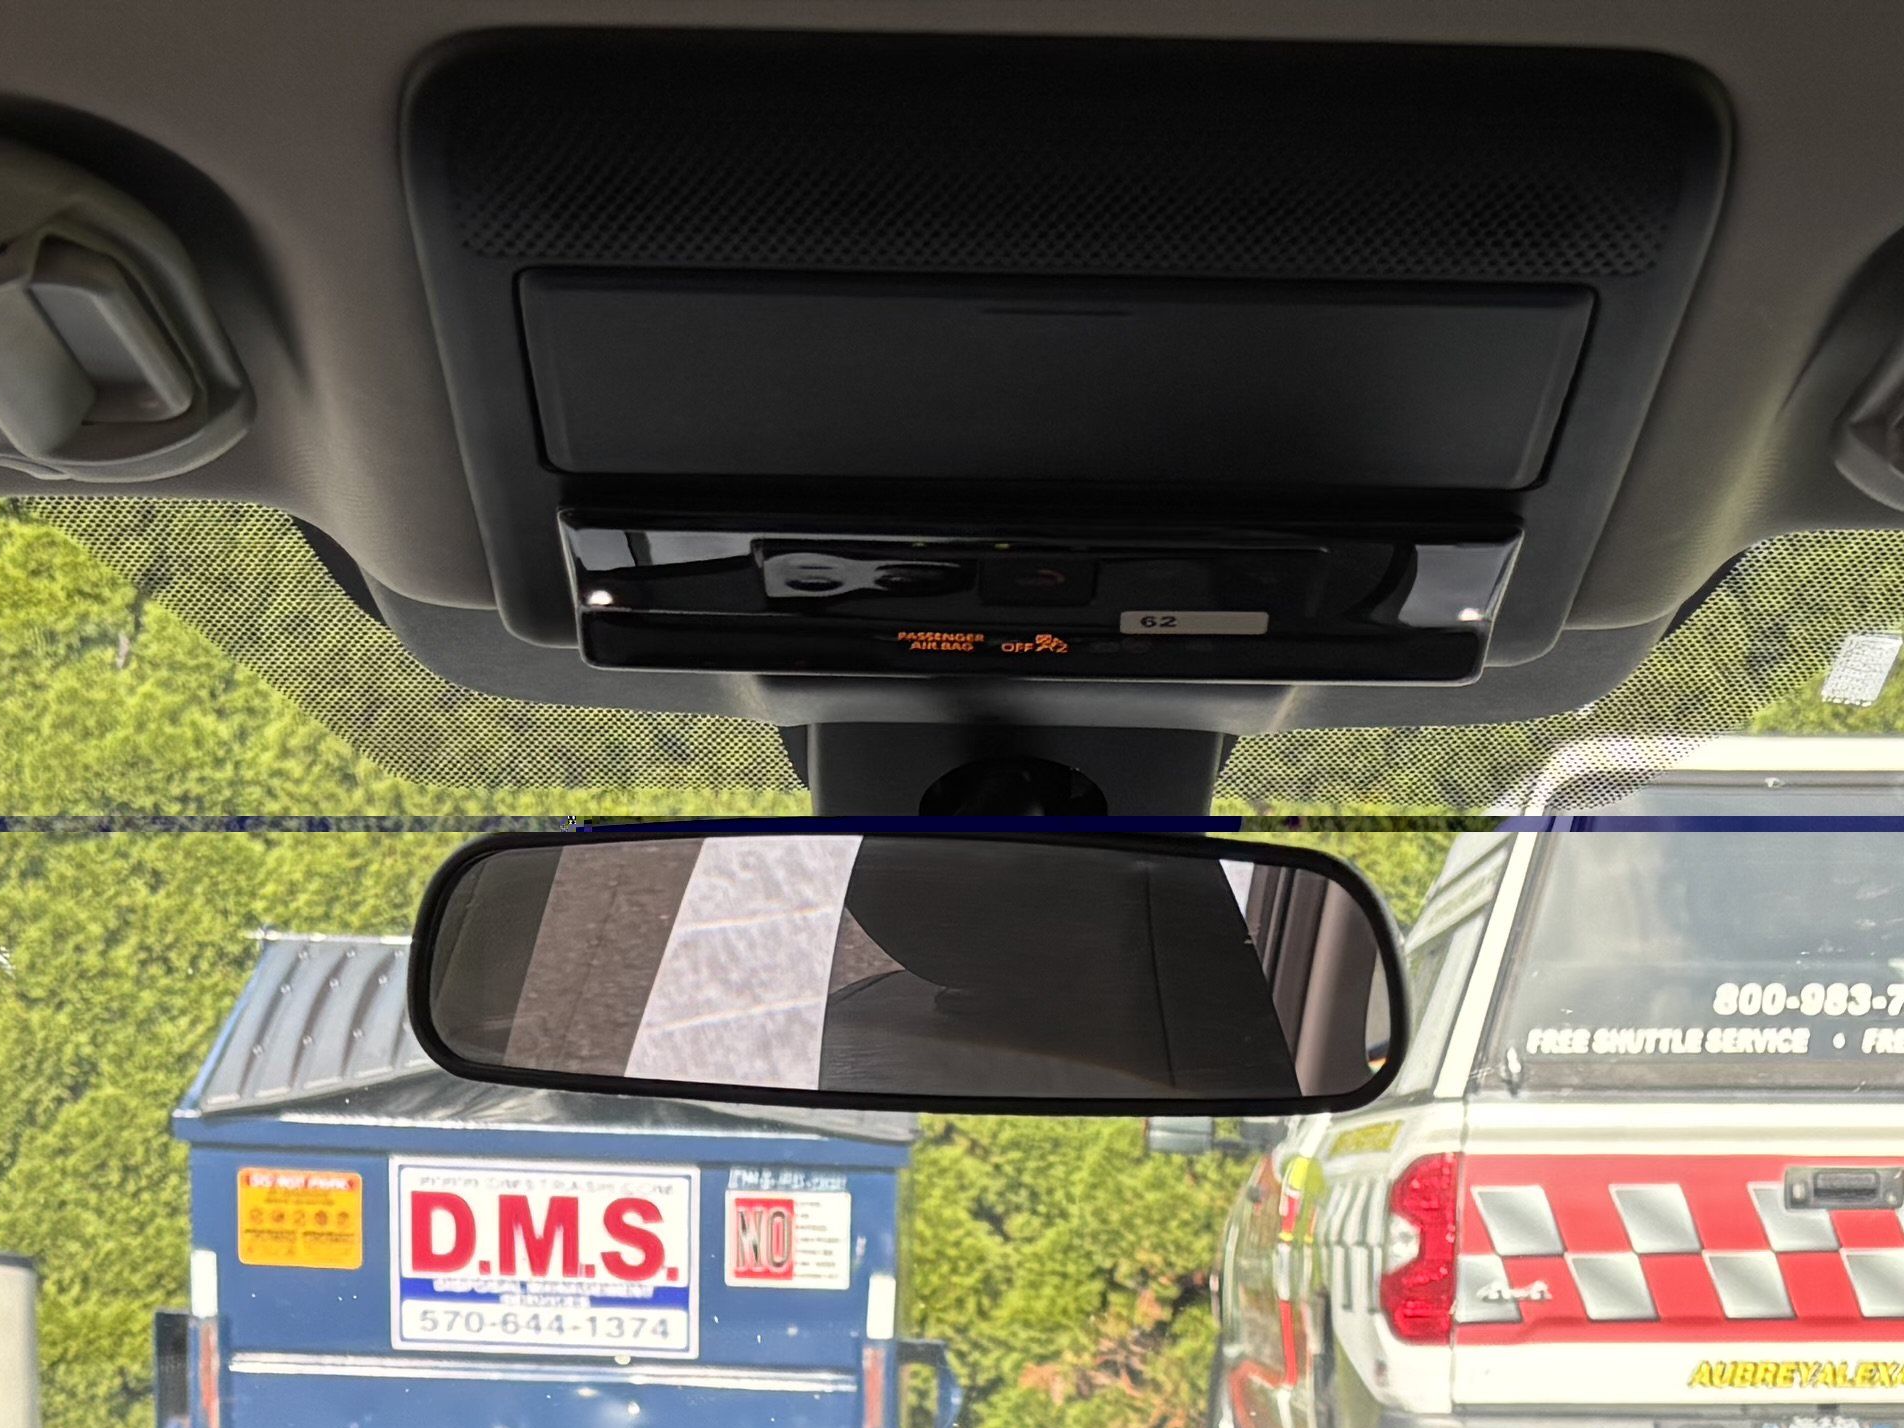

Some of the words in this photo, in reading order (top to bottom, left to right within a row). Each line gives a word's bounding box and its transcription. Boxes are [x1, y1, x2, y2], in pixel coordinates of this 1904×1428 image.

[898, 632, 984, 643] PASSENGER
[1001, 643, 1033, 653] OFF
[1526, 1027, 1590, 1054] FREE
[1593, 1027, 1703, 1054] SHUTTLE
[1705, 1027, 1810, 1054] SERVICE
[411, 1190, 679, 1281] D.M.S.
[736, 1206, 791, 1272] NO
[420, 1309, 671, 1339] 570-644-1374
